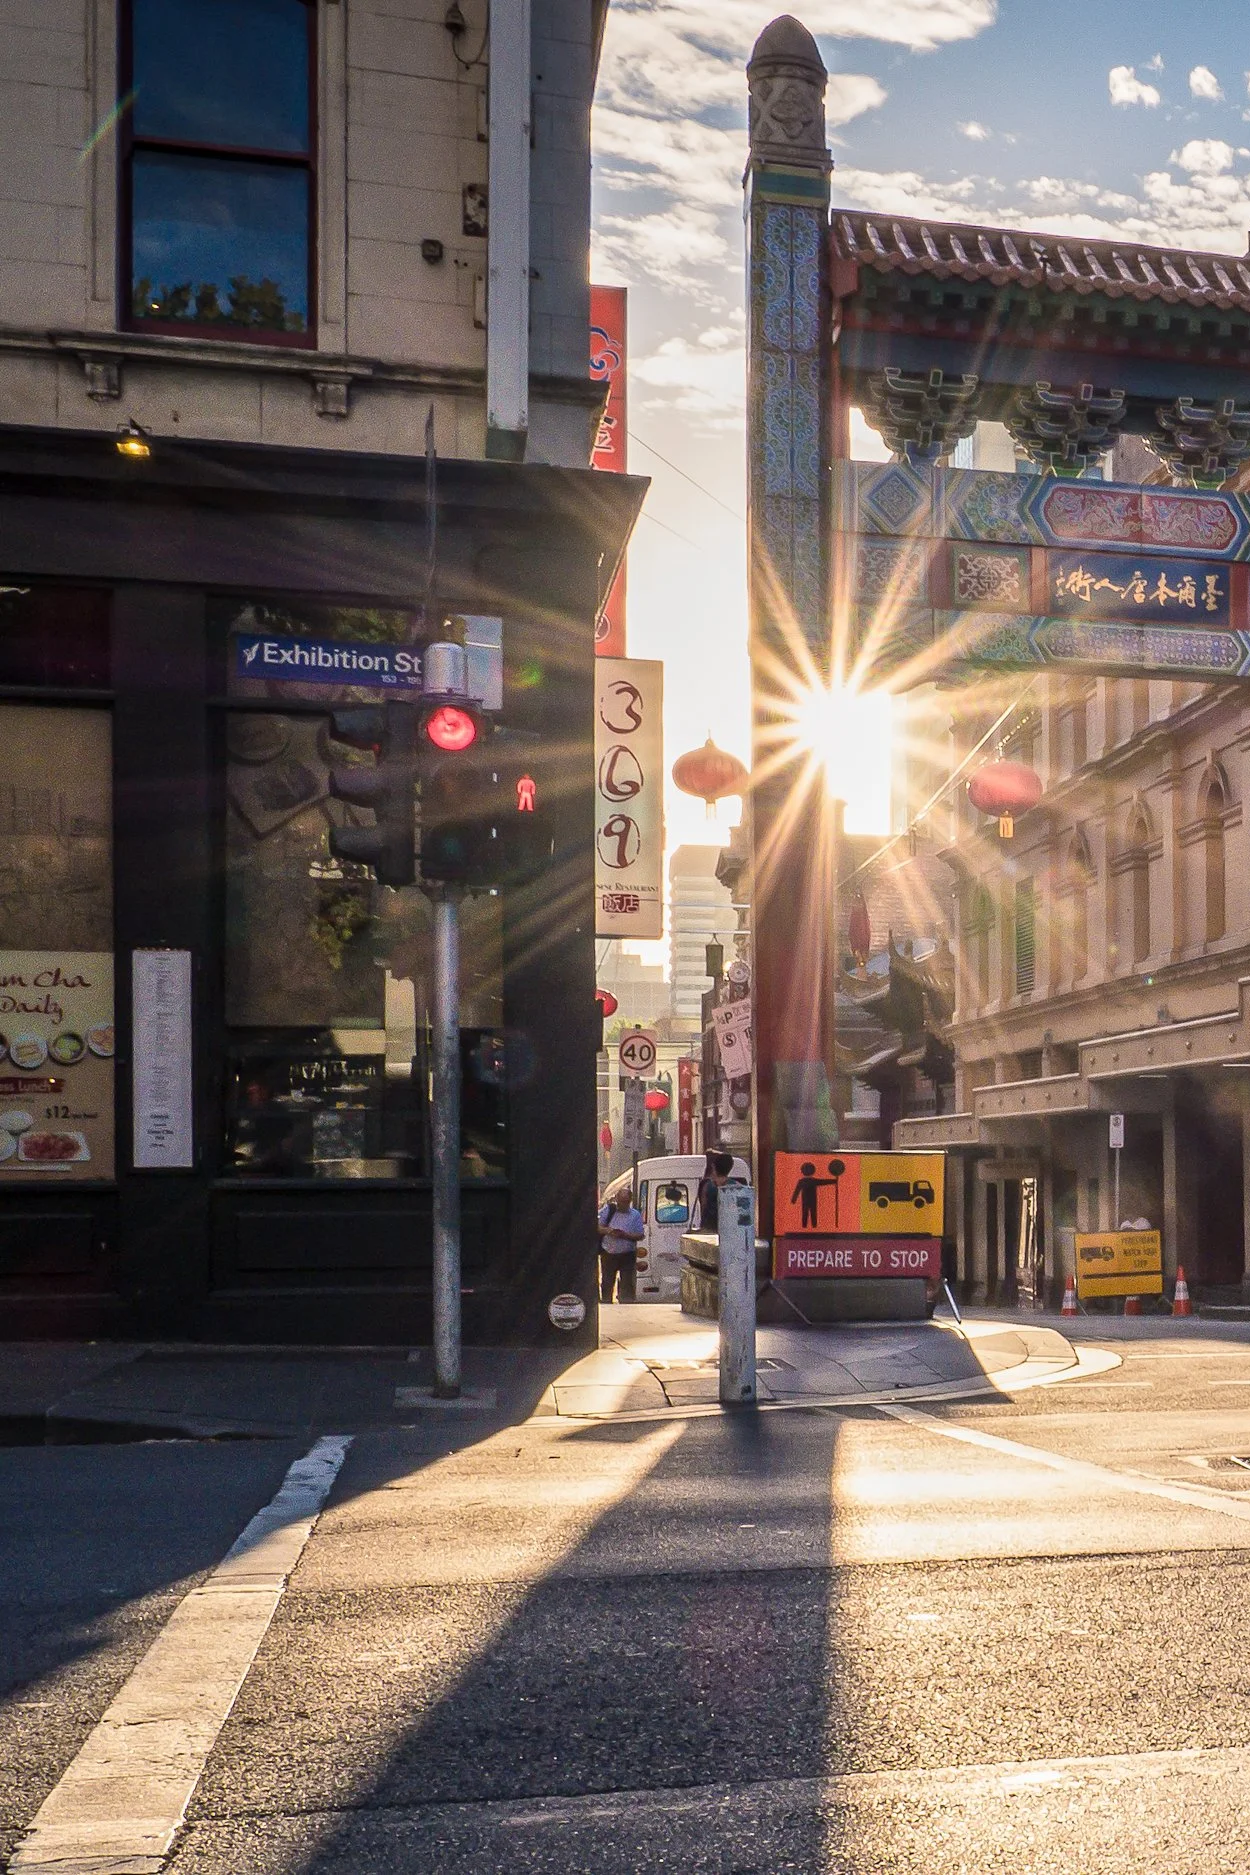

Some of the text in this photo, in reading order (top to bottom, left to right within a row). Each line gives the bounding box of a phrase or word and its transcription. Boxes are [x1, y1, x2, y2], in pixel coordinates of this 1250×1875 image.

[263, 642, 422, 674] Exhibition St
[33, 967, 92, 988] Cha
[0, 993, 63, 1025] Daily
[623, 1043, 651, 1062] 40
[787, 1250, 929, 1268] PREPARE TO STOP
